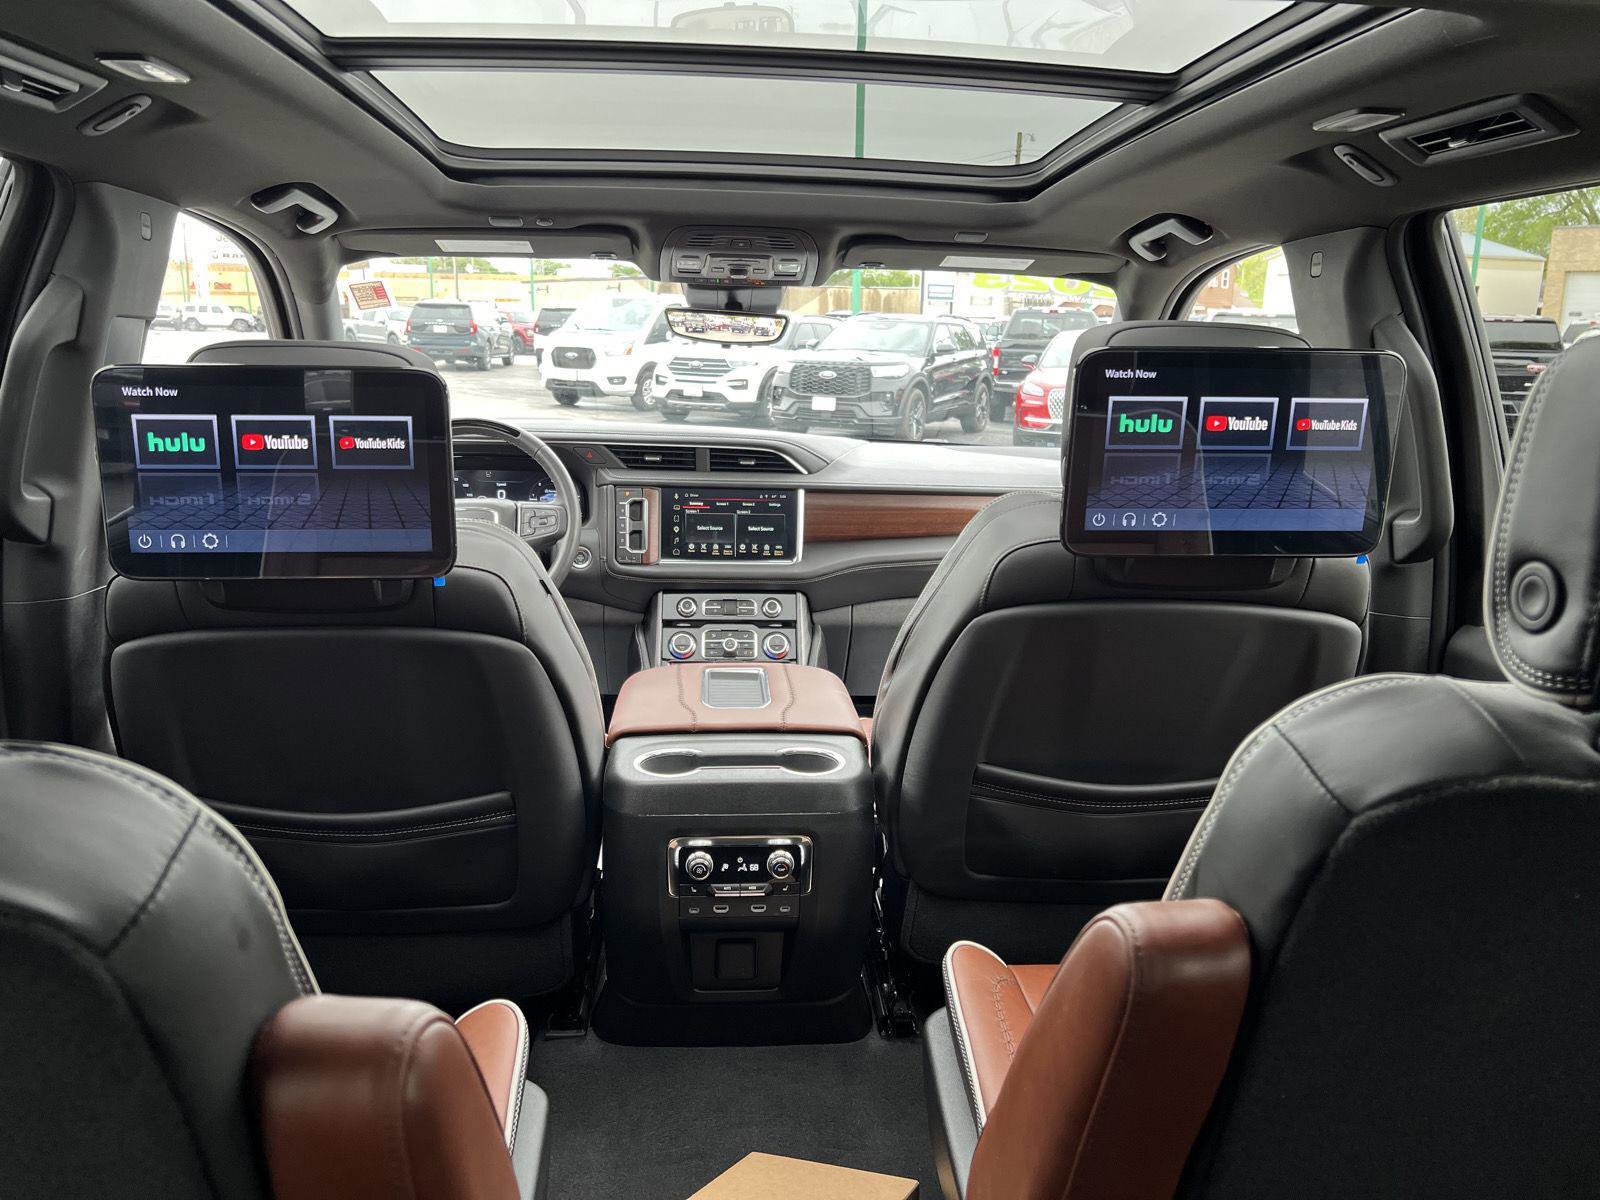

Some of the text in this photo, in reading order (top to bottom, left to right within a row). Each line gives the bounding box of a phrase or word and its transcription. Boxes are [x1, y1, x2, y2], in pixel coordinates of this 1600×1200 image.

[1105, 369, 1157, 379] Watch Now
[121, 386, 178, 397] Watch Now
[1118, 414, 1173, 433] hulu
[1227, 416, 1269, 432] YouTube
[1311, 419, 1358, 432] YouTube Kids
[147, 432, 206, 453] hulu
[264, 434, 309, 451] YouTube
[354, 437, 406, 450] YouTube Kids
